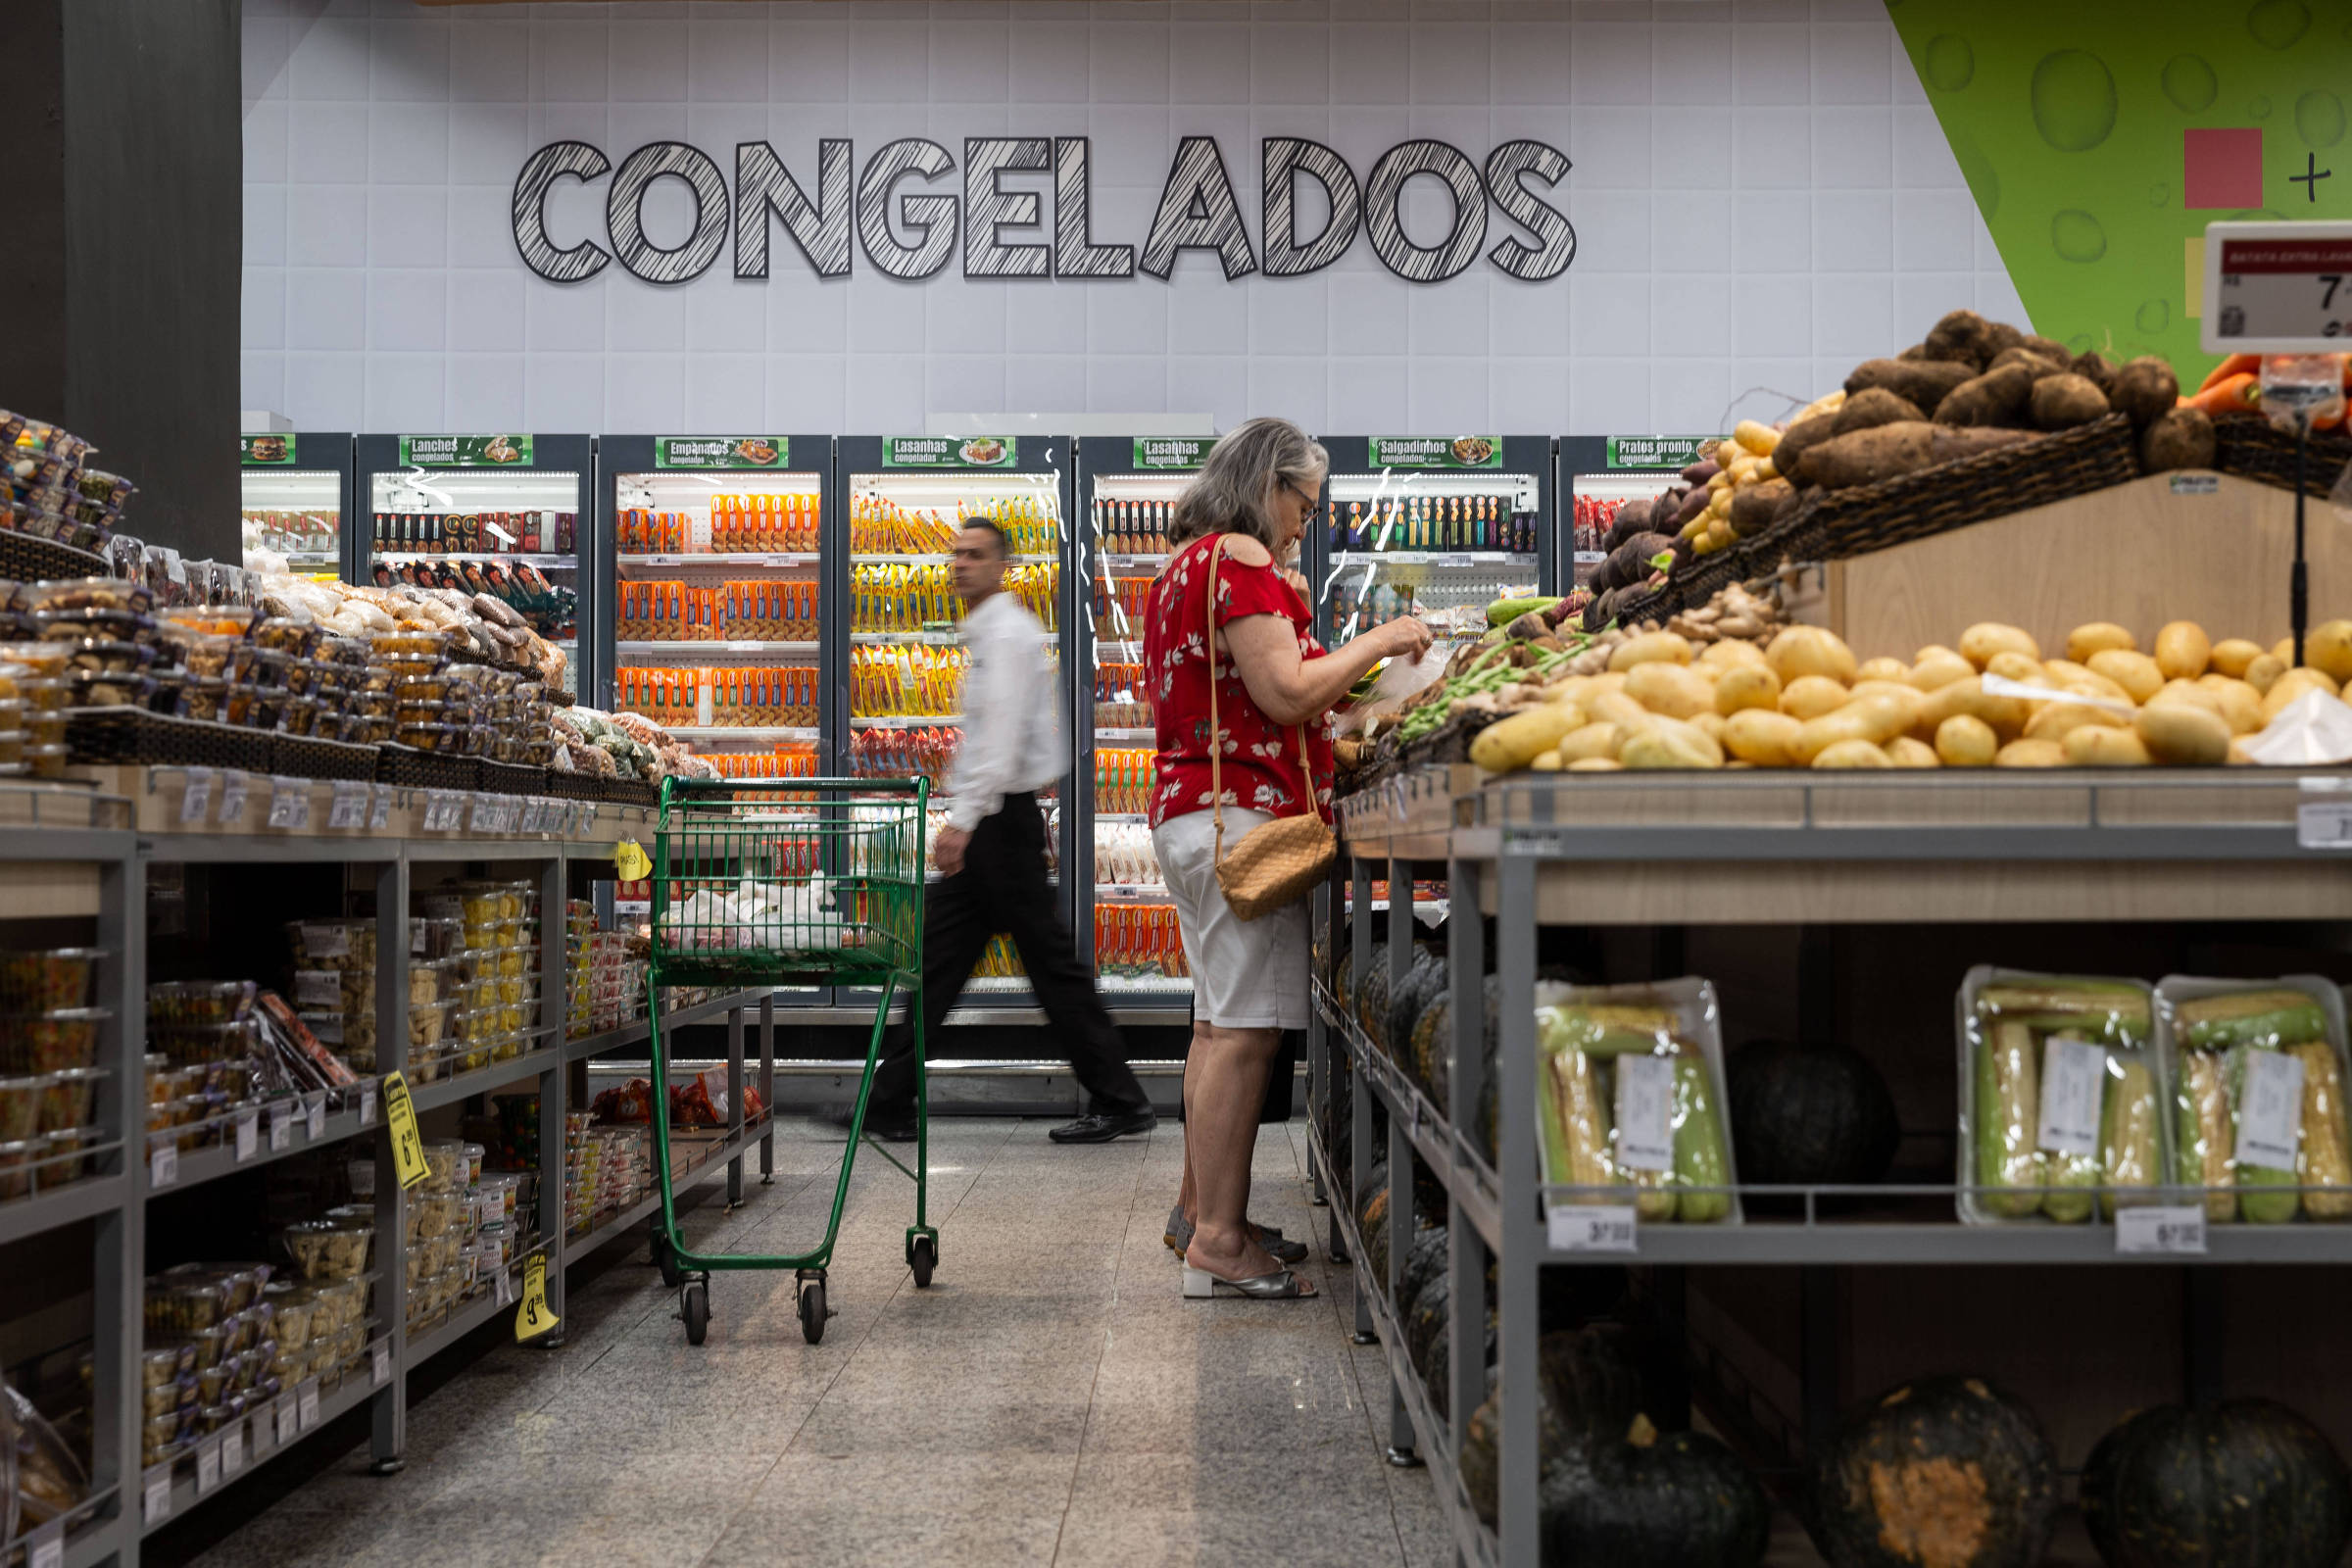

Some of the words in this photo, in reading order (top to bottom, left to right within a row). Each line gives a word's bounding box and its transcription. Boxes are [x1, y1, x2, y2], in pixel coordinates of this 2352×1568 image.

[511, 136, 1579, 283] CONGELADOS
[412, 438, 458, 452] Lanches
[670, 441, 728, 456] Empanados
[895, 438, 947, 453] Lasanhas
[1147, 440, 1199, 455] Lasanhas
[1381, 439, 1446, 455] Salgadinhos
[1619, 440, 1654, 453] Pratos
[412, 453, 454, 463] congelados
